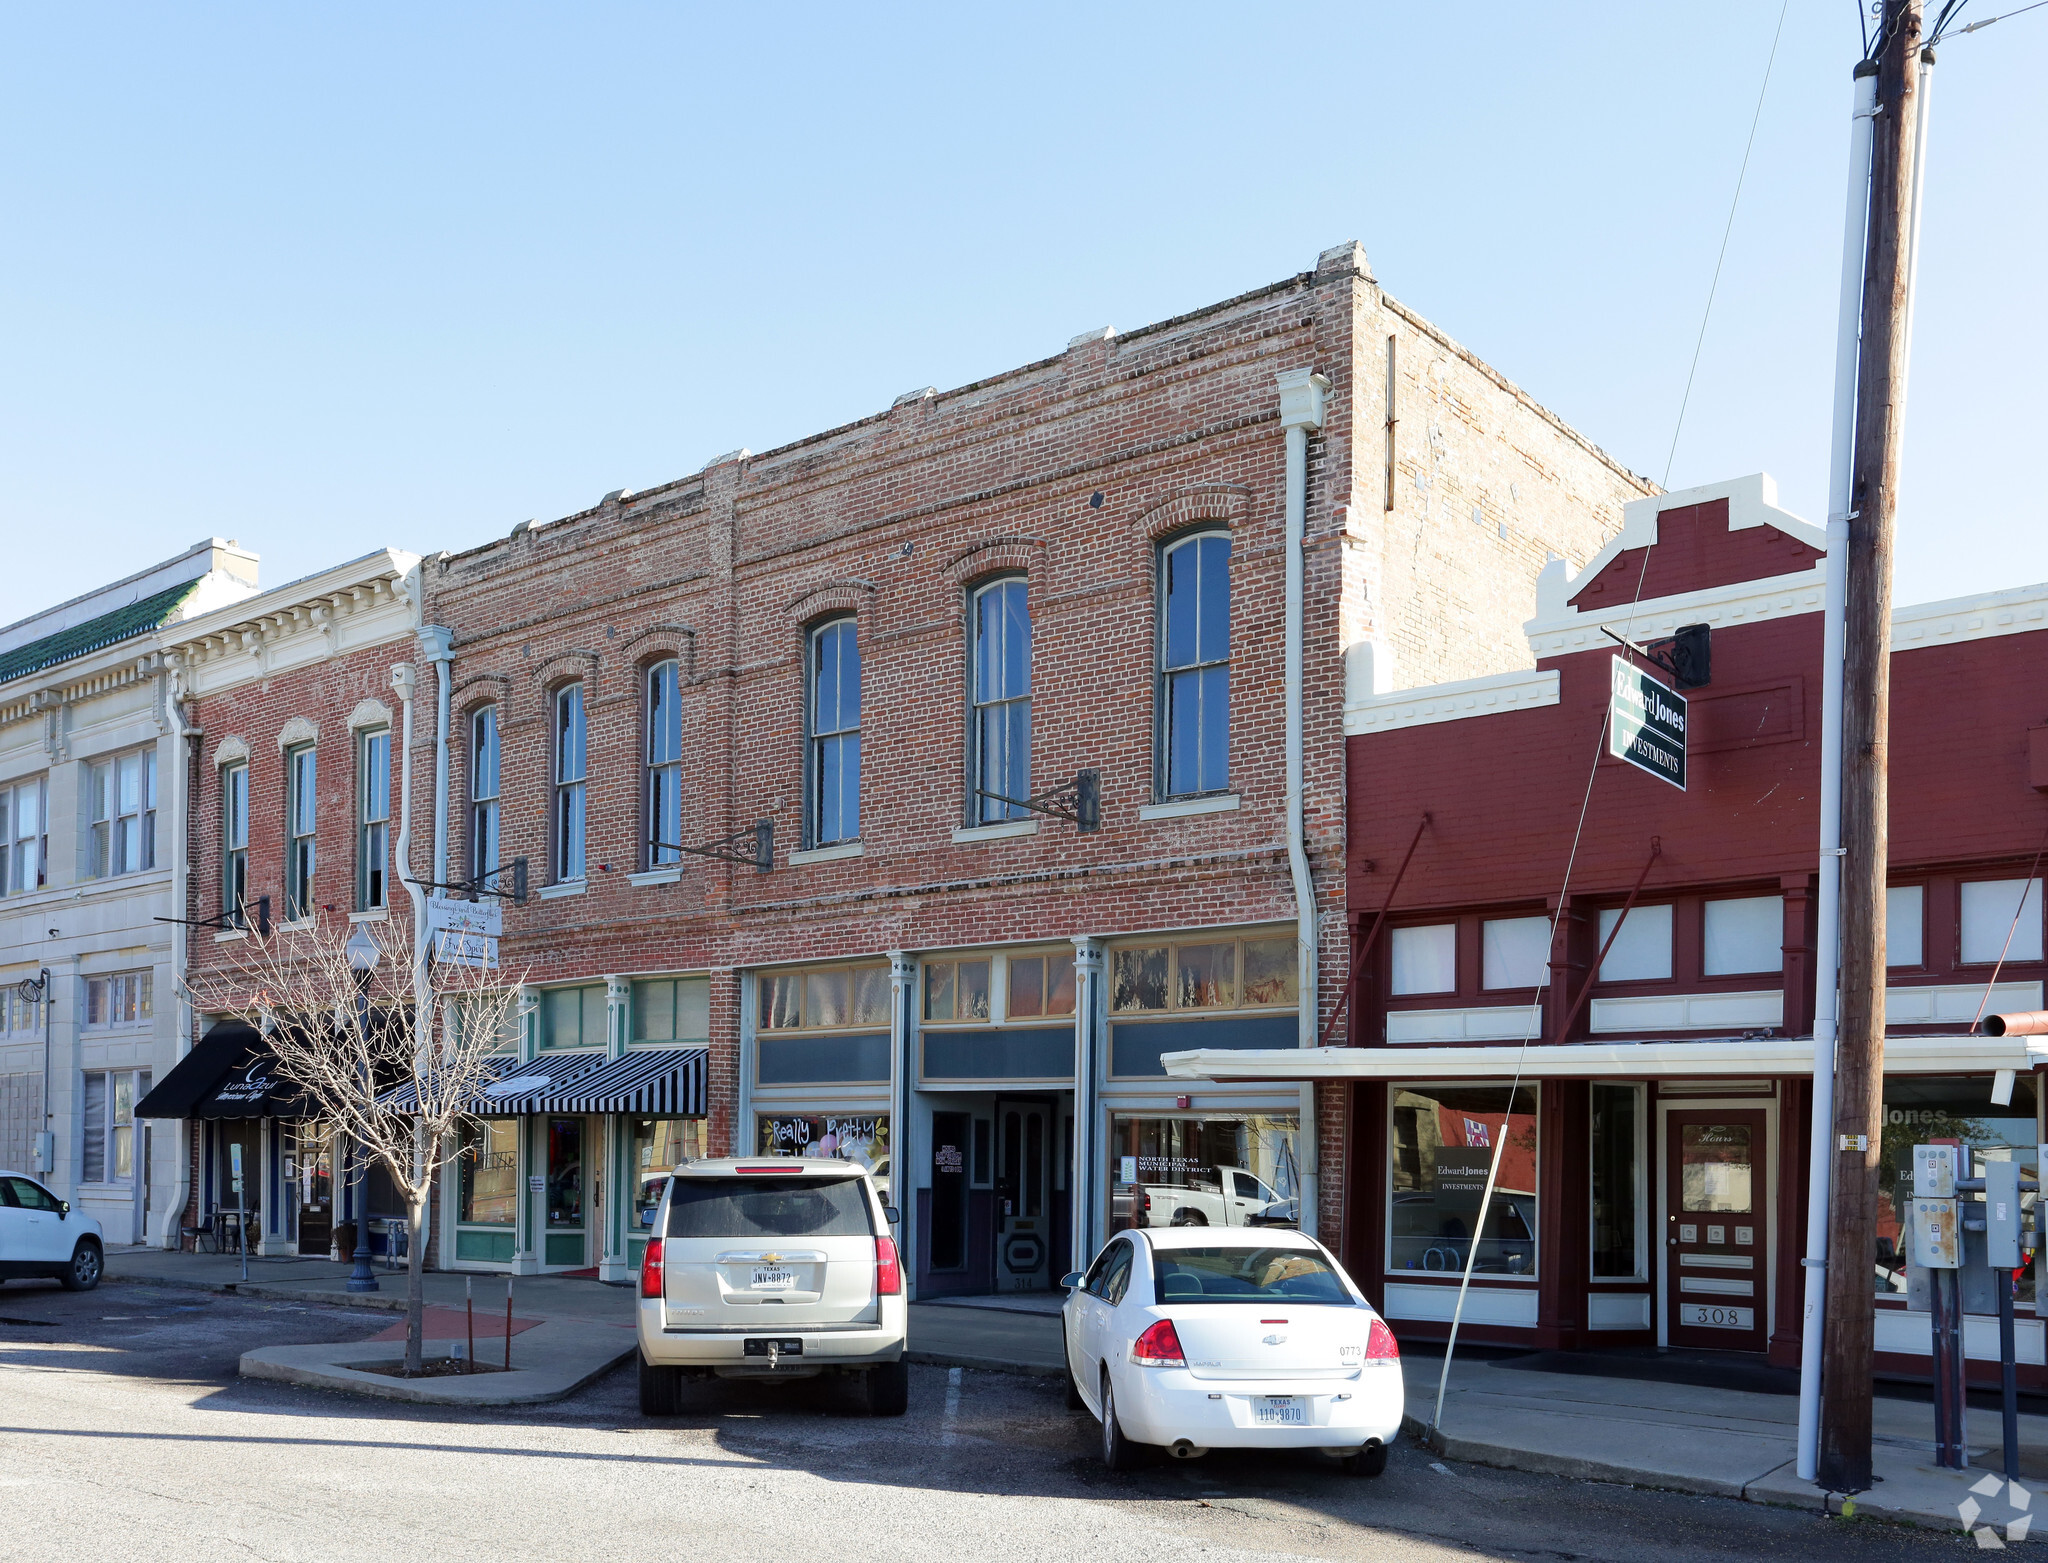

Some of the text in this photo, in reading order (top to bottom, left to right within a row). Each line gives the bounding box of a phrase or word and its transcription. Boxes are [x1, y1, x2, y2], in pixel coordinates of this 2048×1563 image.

[1622, 729, 1679, 774] INVESTMENTS
[773, 1118, 875, 1148] Really Pretty
[1698, 1133, 1733, 1144] Hours
[1697, 1308, 1738, 1325] 308
[1340, 1346, 1361, 1356] 0773
